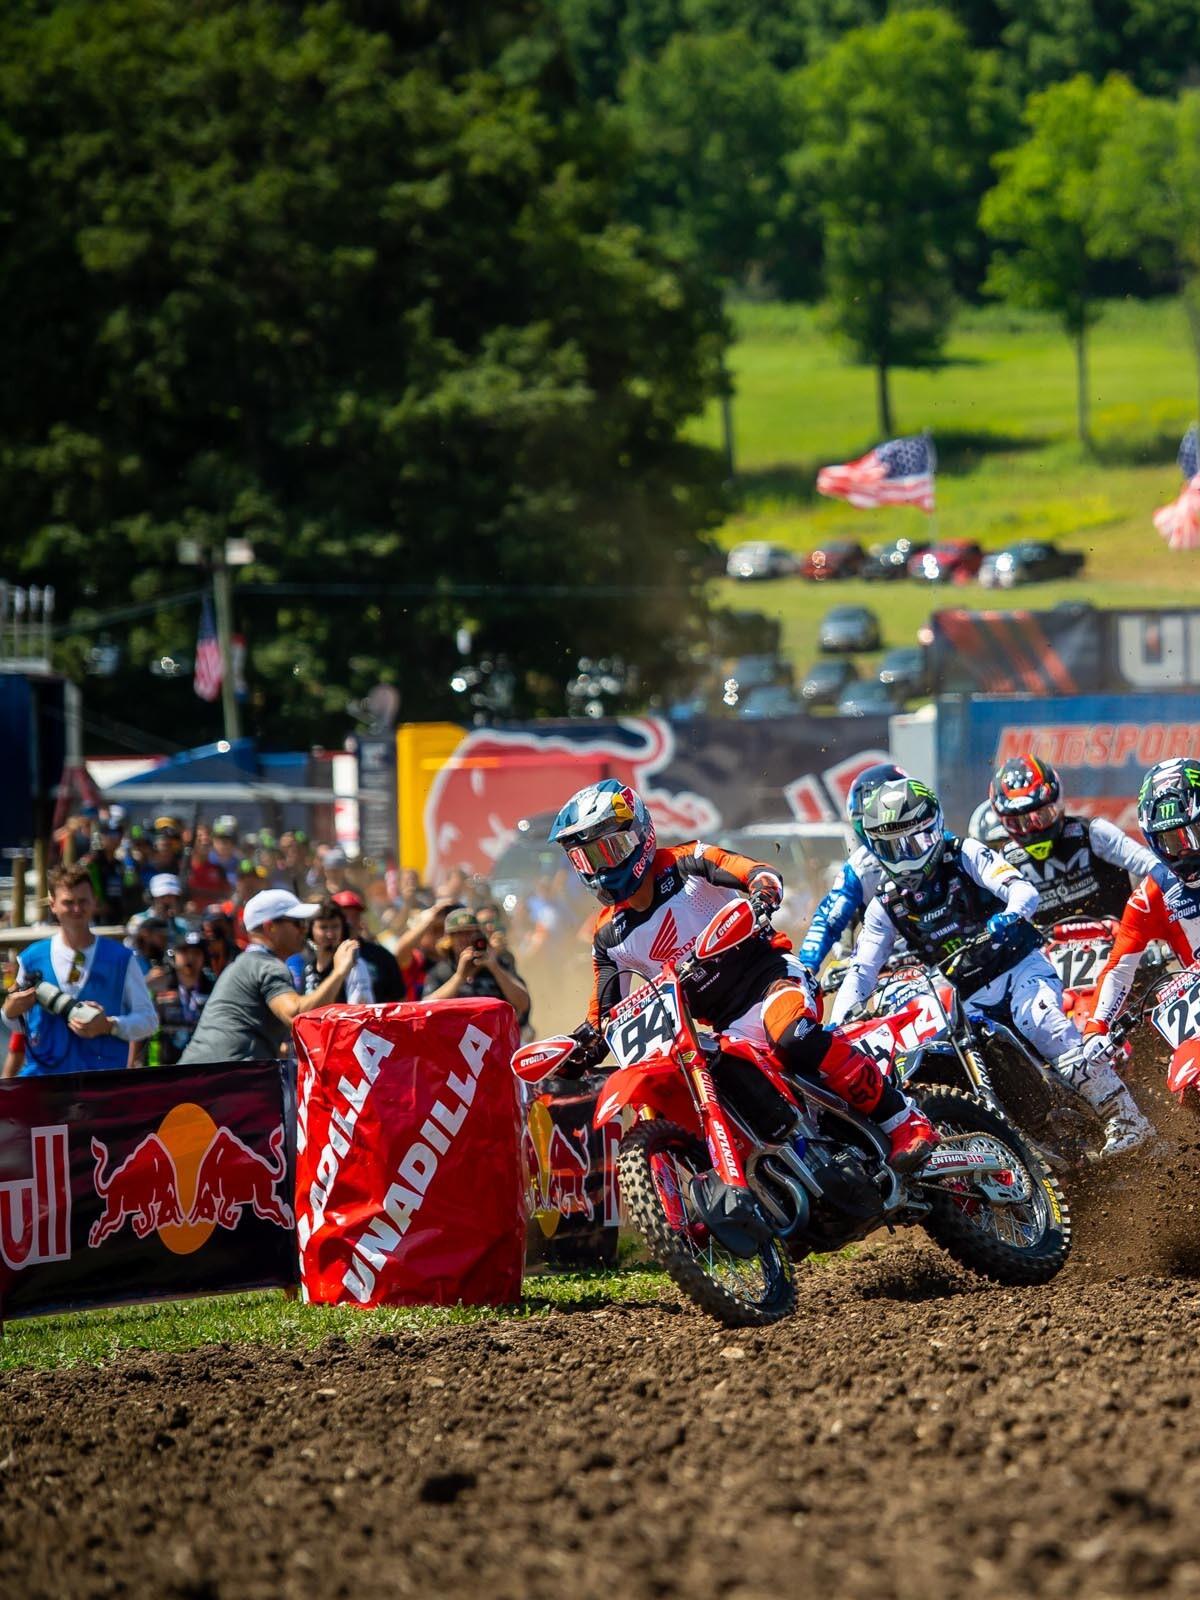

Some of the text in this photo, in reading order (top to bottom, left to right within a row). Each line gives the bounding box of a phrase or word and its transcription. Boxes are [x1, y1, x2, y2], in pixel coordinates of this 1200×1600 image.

[718, 911, 741, 937] CYCRA
[923, 905, 947, 922] thor
[1167, 904, 1197, 924] SHOWA
[621, 1000, 675, 1065] 94
[519, 1053, 546, 1069] CYCRA
[298, 1028, 395, 1250] ADILLA
[712, 1120, 740, 1178] DUNLOP
[930, 1153, 967, 1165] ENTHAL
[342, 1023, 494, 1303] UNADILLA
[0, 1124, 71, 1271] ull
[1041, 1178, 1063, 1224] DUNLOP
